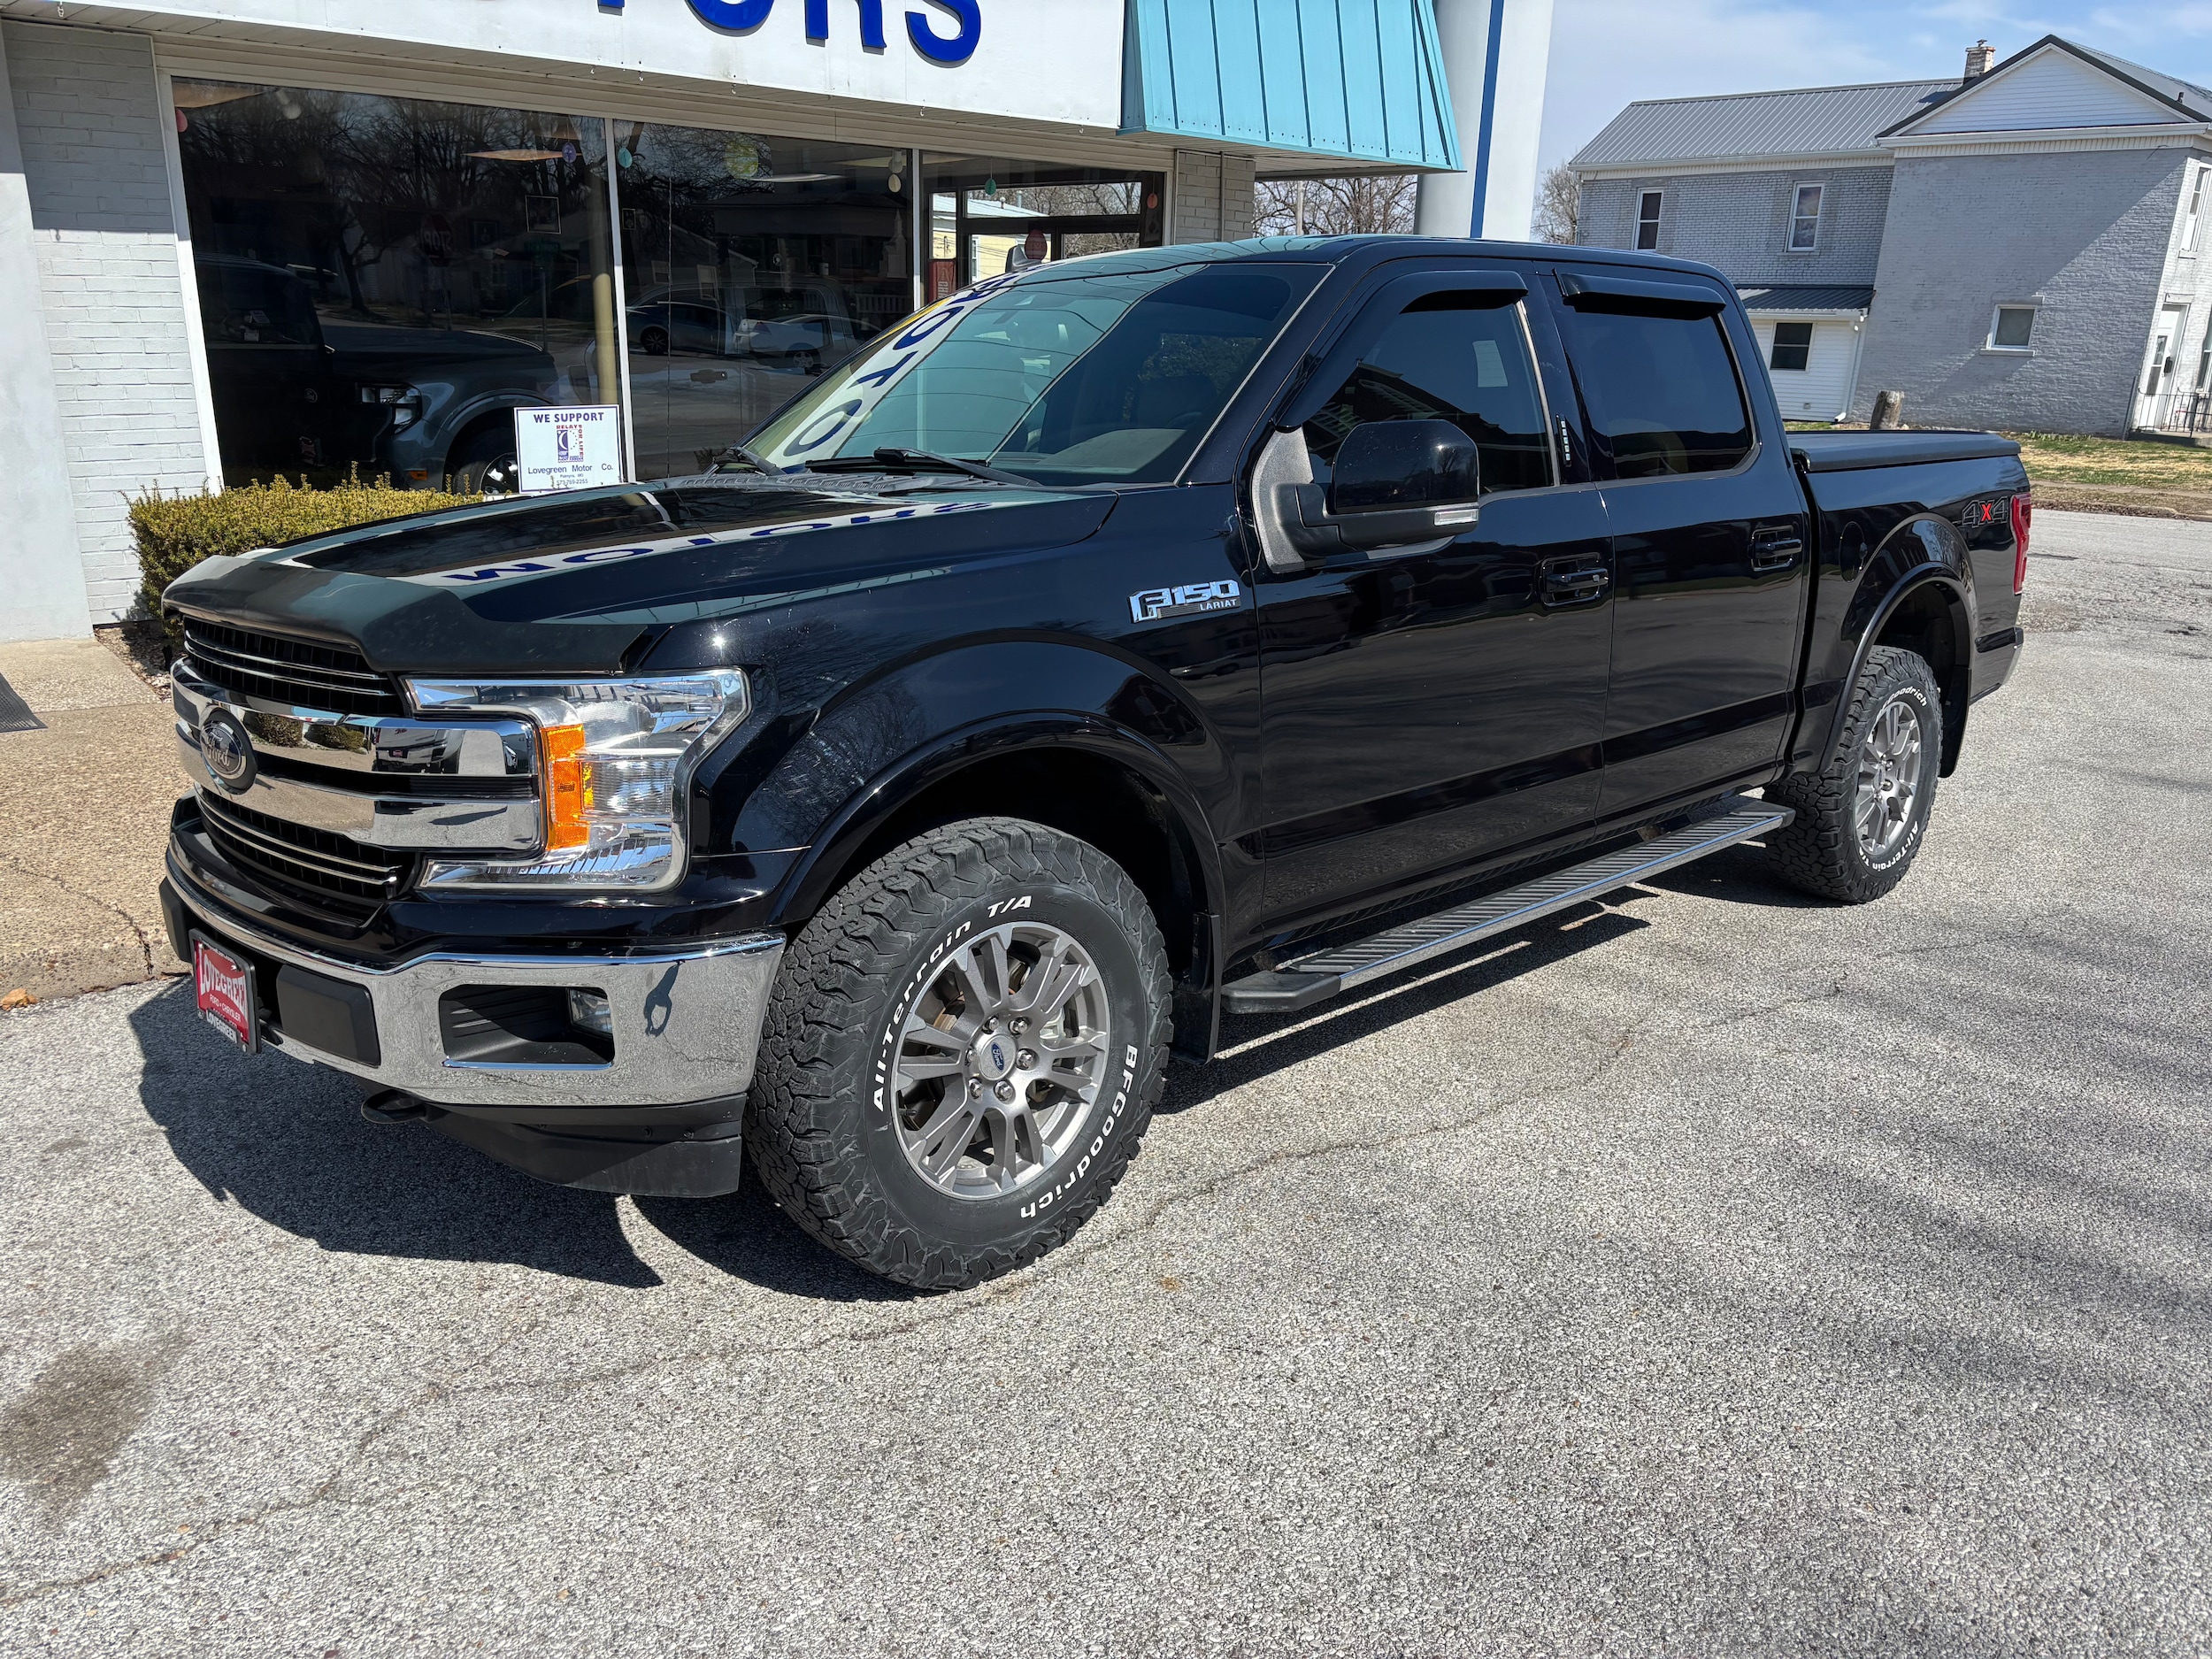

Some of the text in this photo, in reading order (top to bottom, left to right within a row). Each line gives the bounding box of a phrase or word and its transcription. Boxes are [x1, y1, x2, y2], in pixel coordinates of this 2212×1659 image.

[534, 412, 604, 423] WE SUPPORT
[528, 466, 567, 475] Lovegreen
[1199, 598, 1237, 611] LARIAT
[1872, 820, 1918, 872] All-Terrain
[873, 920, 972, 1112] All-Terrain
[987, 895, 1033, 918] T/A
[1019, 1044, 1139, 1219] BFGoodrich
